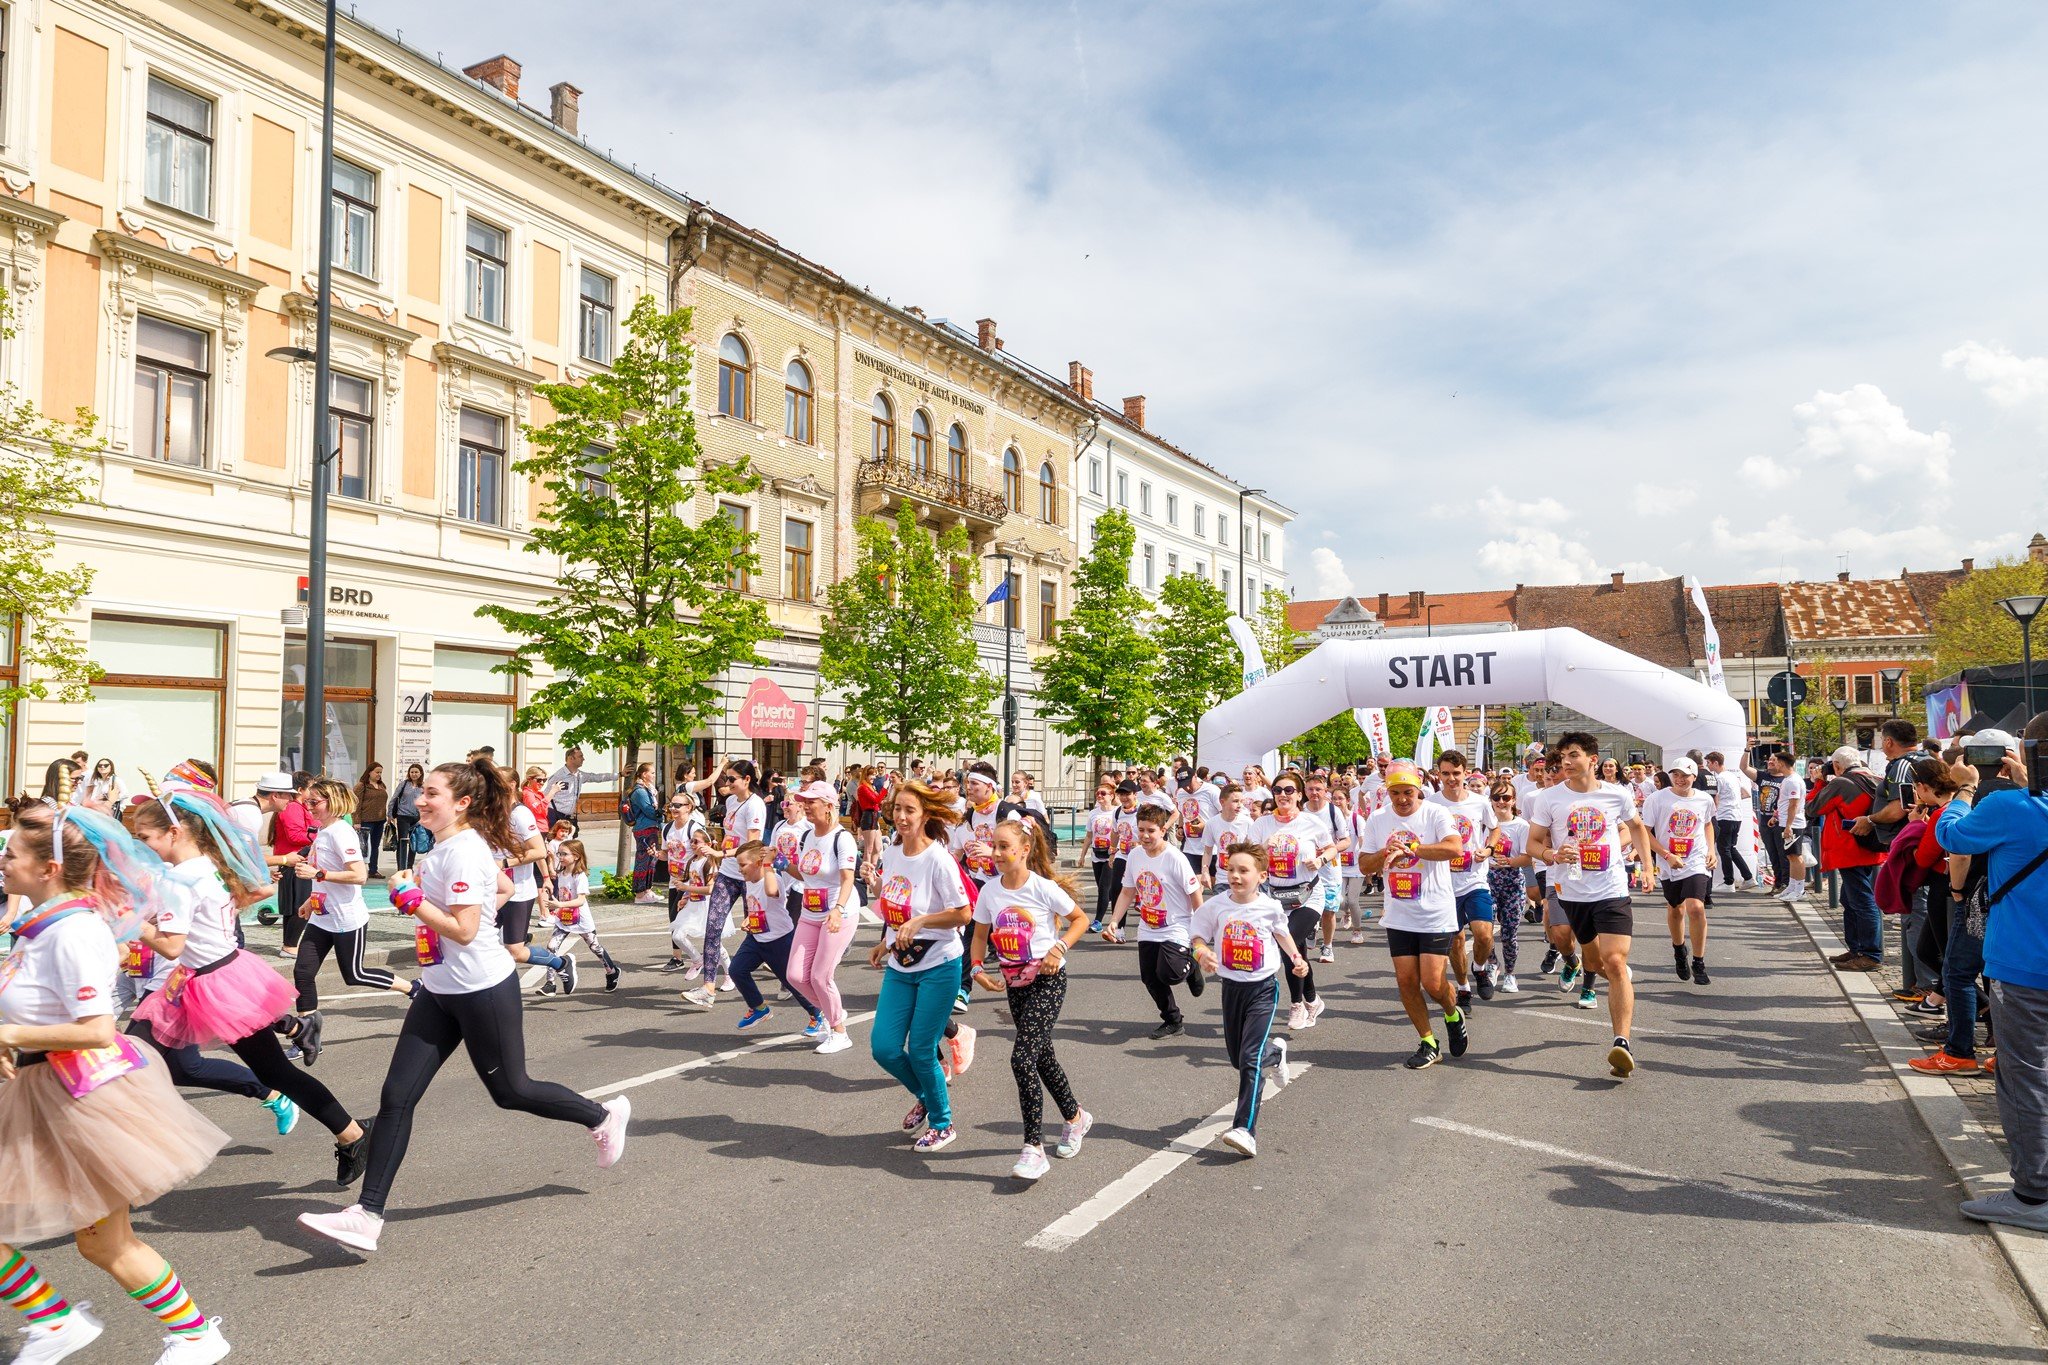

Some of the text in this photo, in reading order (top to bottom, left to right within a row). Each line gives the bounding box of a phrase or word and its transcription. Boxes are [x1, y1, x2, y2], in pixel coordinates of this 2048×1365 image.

[855, 350, 917, 387] UNIVERSITATEA
[919, 381, 929, 392] DE
[959, 398, 985, 416] DESIGN
[330, 587, 373, 605] BRD
[355, 611, 389, 619] GENERALE
[1321, 629, 1380, 638] CLUJ-NAPOCA
[1388, 651, 1497, 689] START
[752, 702, 796, 720] diverta
[1577, 811, 1592, 821] THE
[1577, 821, 1603, 831] COLOR
[1584, 852, 1601, 862] 3752
[888, 909, 904, 923] 1115
[1005, 913, 1019, 922] THE
[1231, 924, 1244, 935] THE
[1000, 937, 1019, 951] 1114
[1232, 948, 1253, 962] 2243
